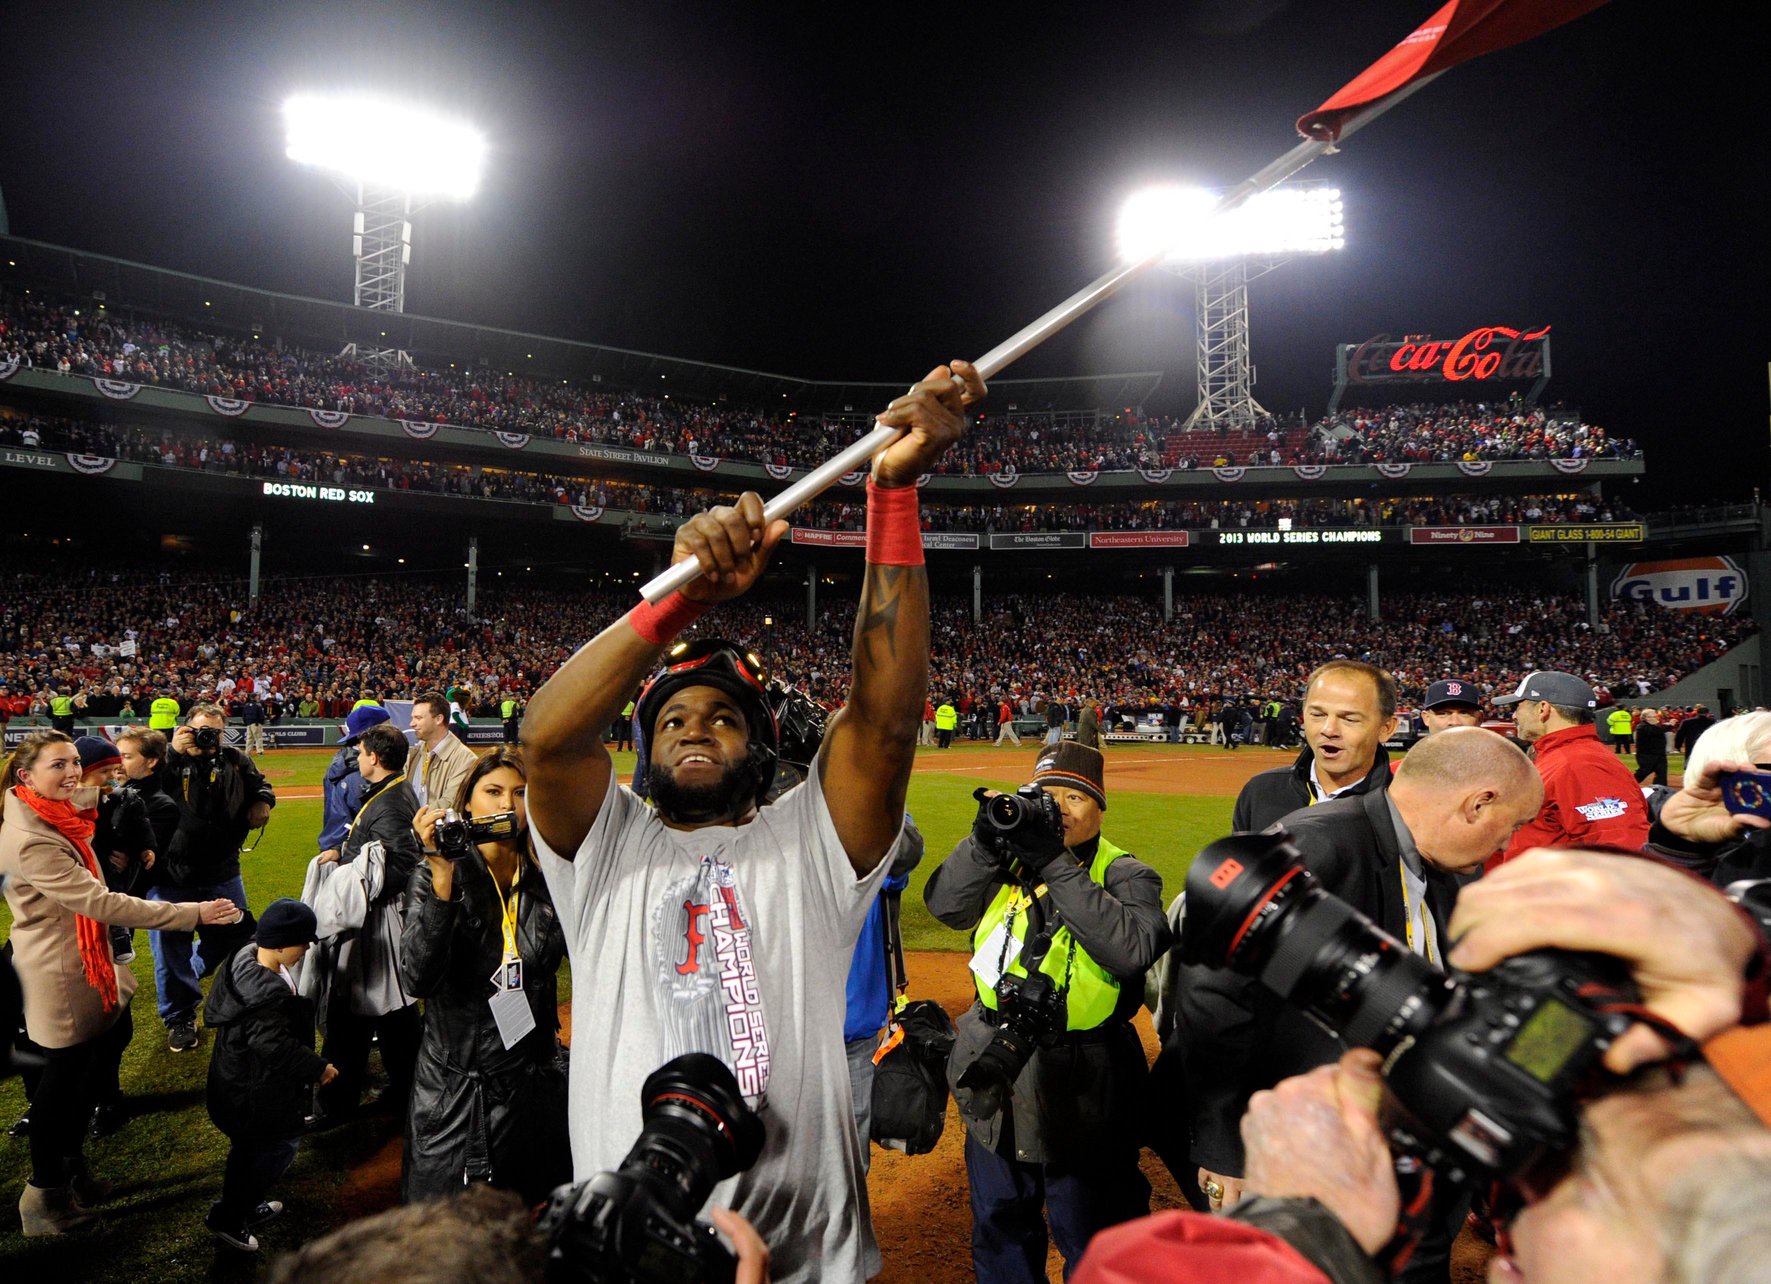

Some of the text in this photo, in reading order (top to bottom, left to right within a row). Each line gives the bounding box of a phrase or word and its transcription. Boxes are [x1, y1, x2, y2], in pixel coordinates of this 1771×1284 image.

[5, 452, 56, 467] LEVEL
[579, 446, 669, 465] STATE STREET PAVILION
[263, 482, 375, 504] BOSTON RED SOX
[804, 532, 868, 541] MAPFRE Commerc
[1095, 535, 1184, 544] Northeastern University
[1219, 531, 1382, 544] 2013 WORLD SERIES CHAMPIONS
[1431, 532, 1459, 540] Ninety
[1532, 530, 1556, 540] GIANT
[1557, 529, 1584, 540] GLASS
[1615, 528, 1640, 539] GIANT
[1619, 576, 1737, 602] Gulf
[1446, 682, 1463, 696] B
[733, 931, 761, 1006] WORLD
[709, 883, 760, 1098] CHAMPIONS
